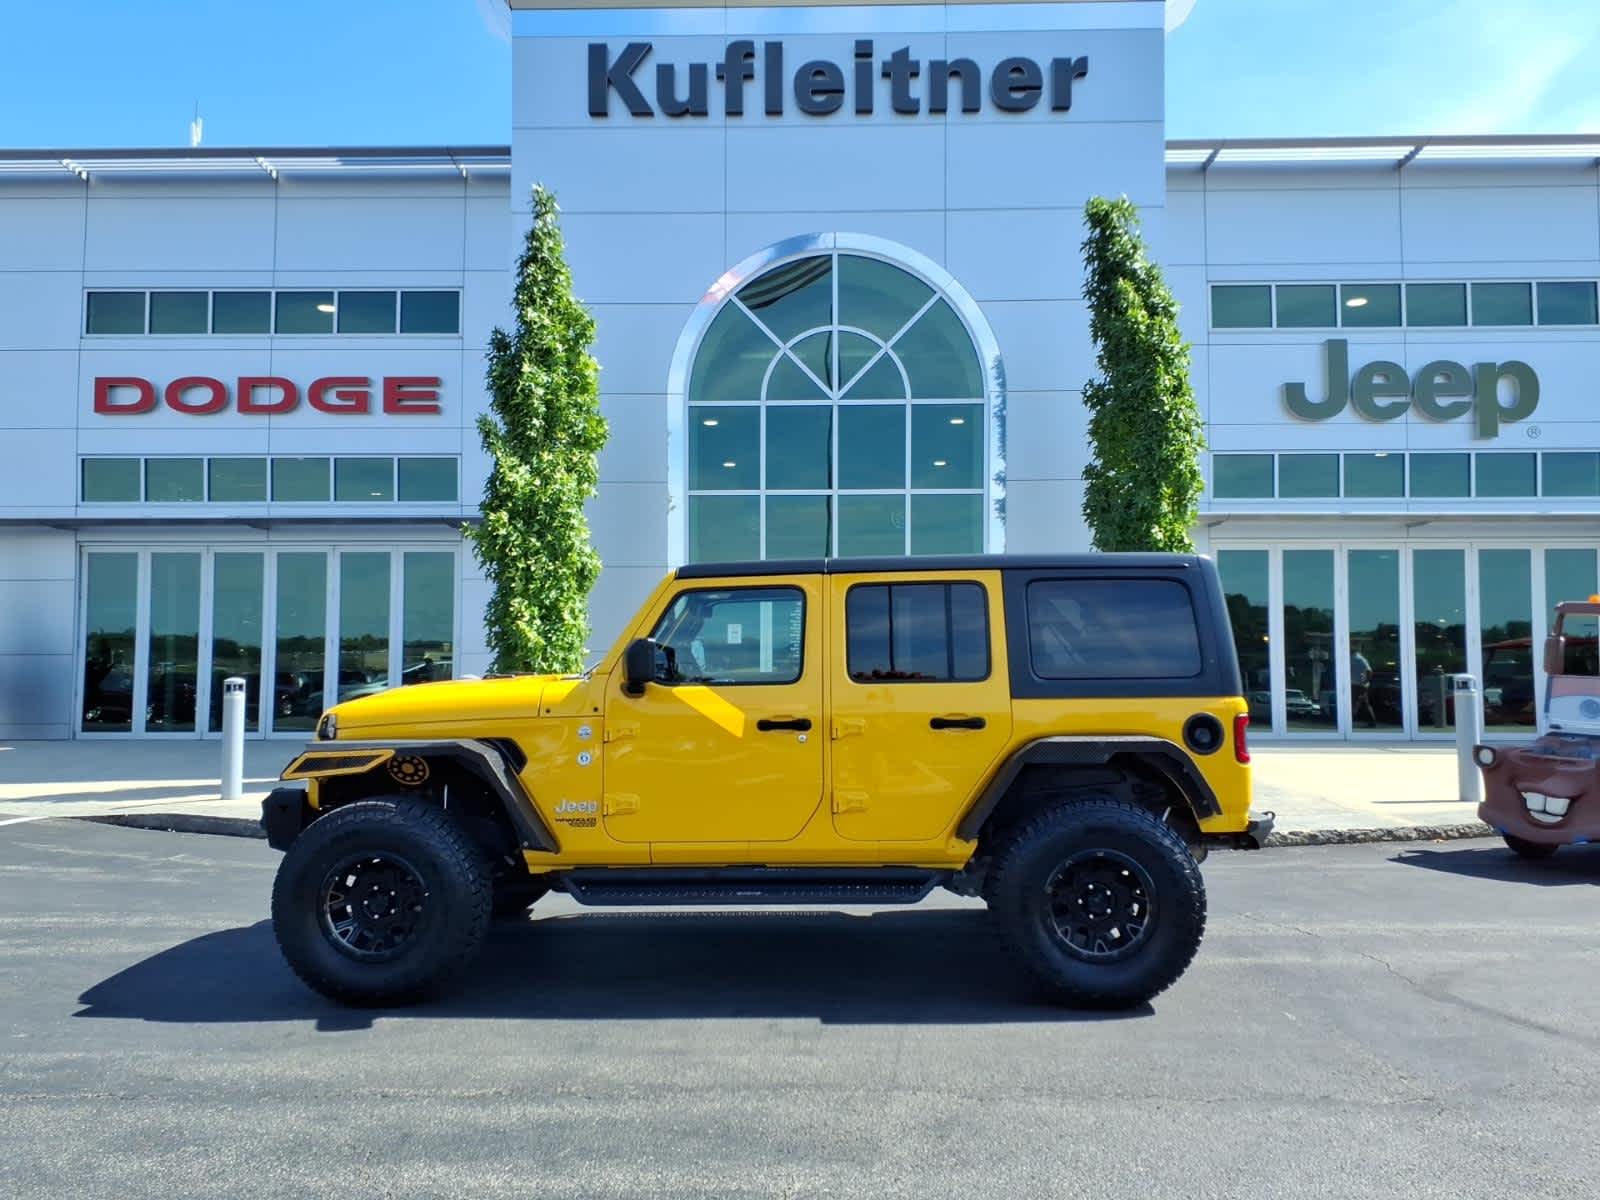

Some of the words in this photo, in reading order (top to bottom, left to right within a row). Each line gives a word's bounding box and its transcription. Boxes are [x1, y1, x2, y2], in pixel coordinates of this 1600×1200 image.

[587, 39, 1088, 118] Kufleitner
[93, 376, 442, 416] DODGE
[1282, 338, 1540, 440] Jeep
[554, 799, 598, 814] Jeep
